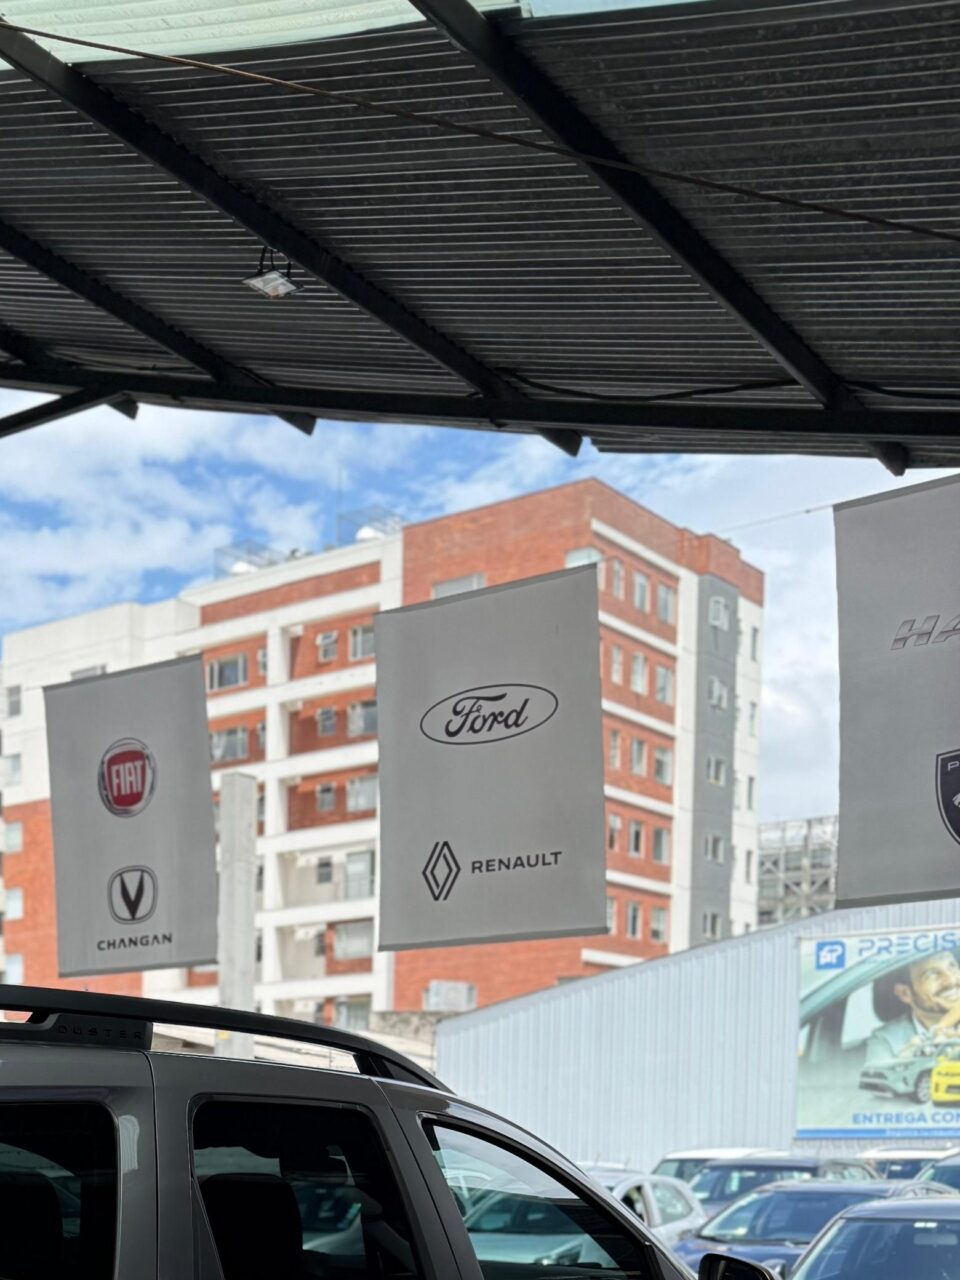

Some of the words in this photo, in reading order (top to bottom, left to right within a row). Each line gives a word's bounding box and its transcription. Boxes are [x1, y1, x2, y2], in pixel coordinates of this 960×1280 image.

[445, 693, 529, 737] Ford
[111, 761, 144, 796] FIAT
[471, 851, 562, 874] RENAULT
[97, 933, 173, 951] CHANGAN
[852, 1111, 928, 1125] ENTREGA
